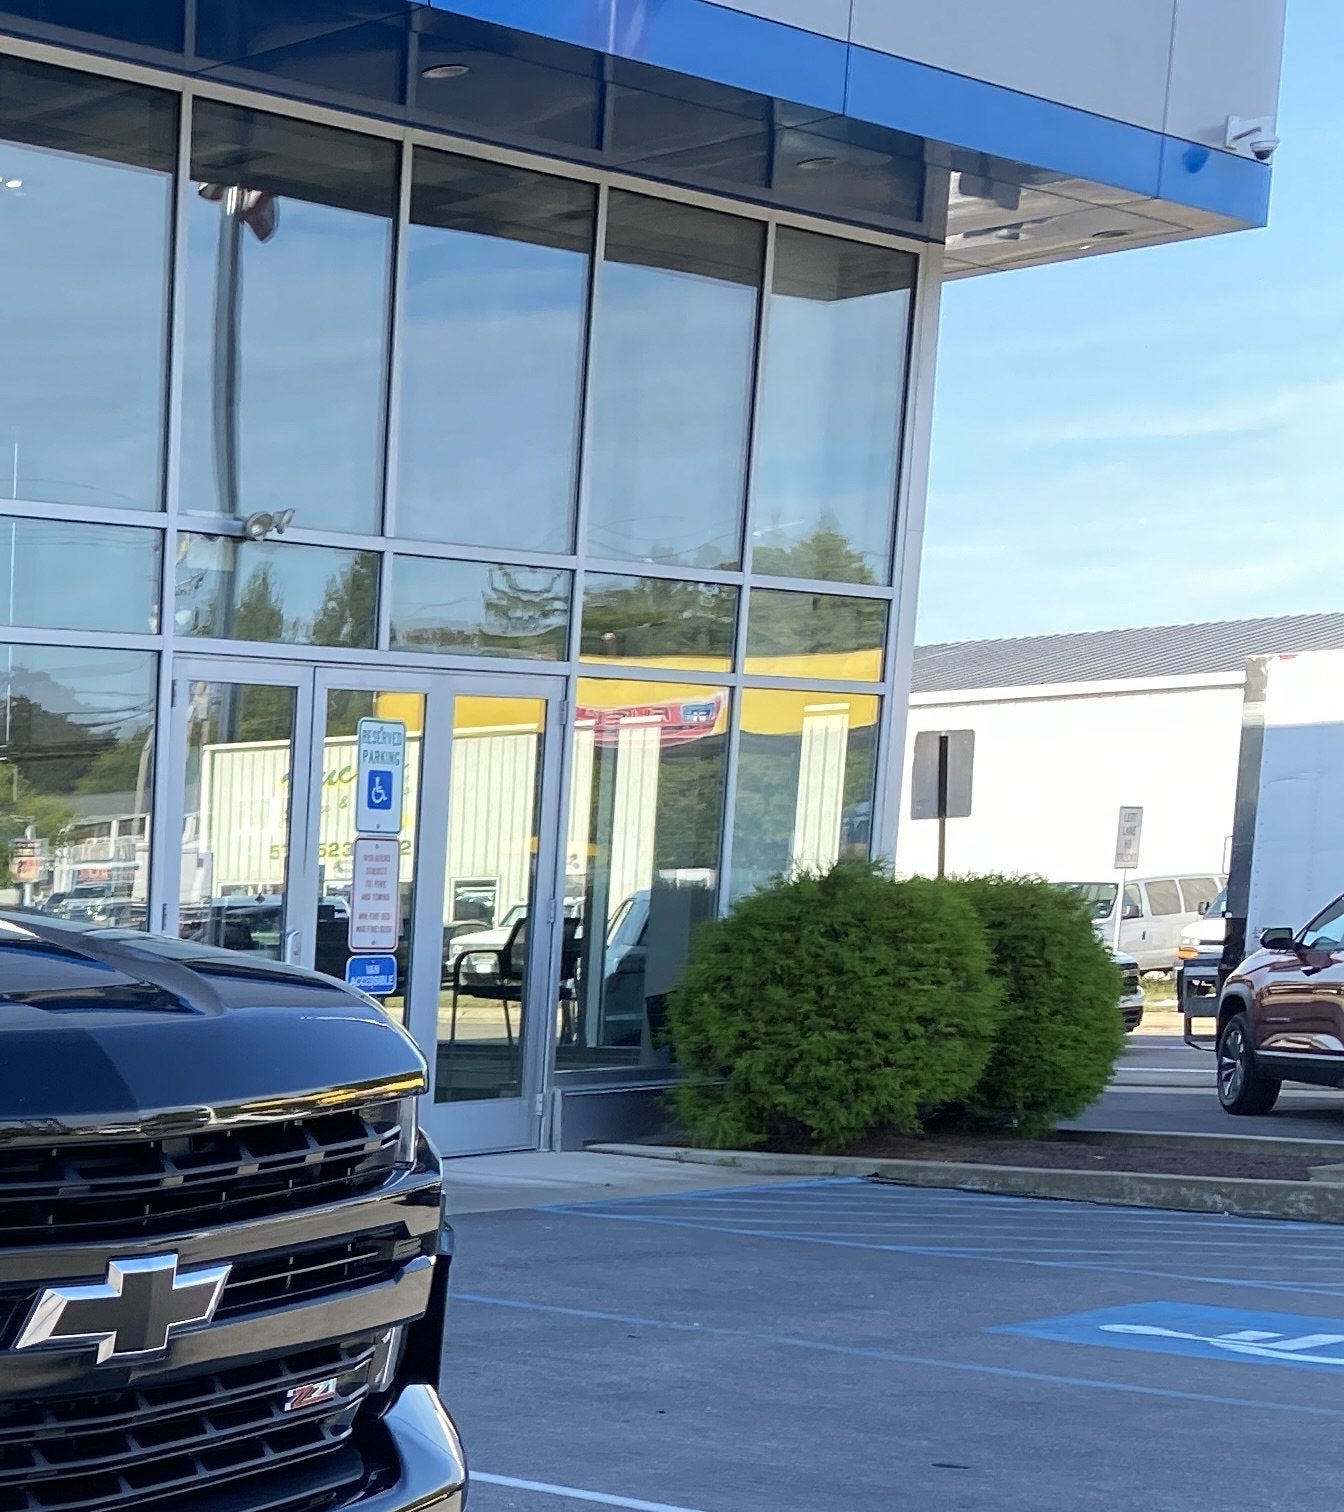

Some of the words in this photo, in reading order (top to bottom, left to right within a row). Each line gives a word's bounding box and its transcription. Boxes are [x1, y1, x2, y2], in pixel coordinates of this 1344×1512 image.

[362, 729, 402, 746] RESERVED
[362, 749, 400, 766] PARKING
[284, 1377, 338, 1412] Z71
